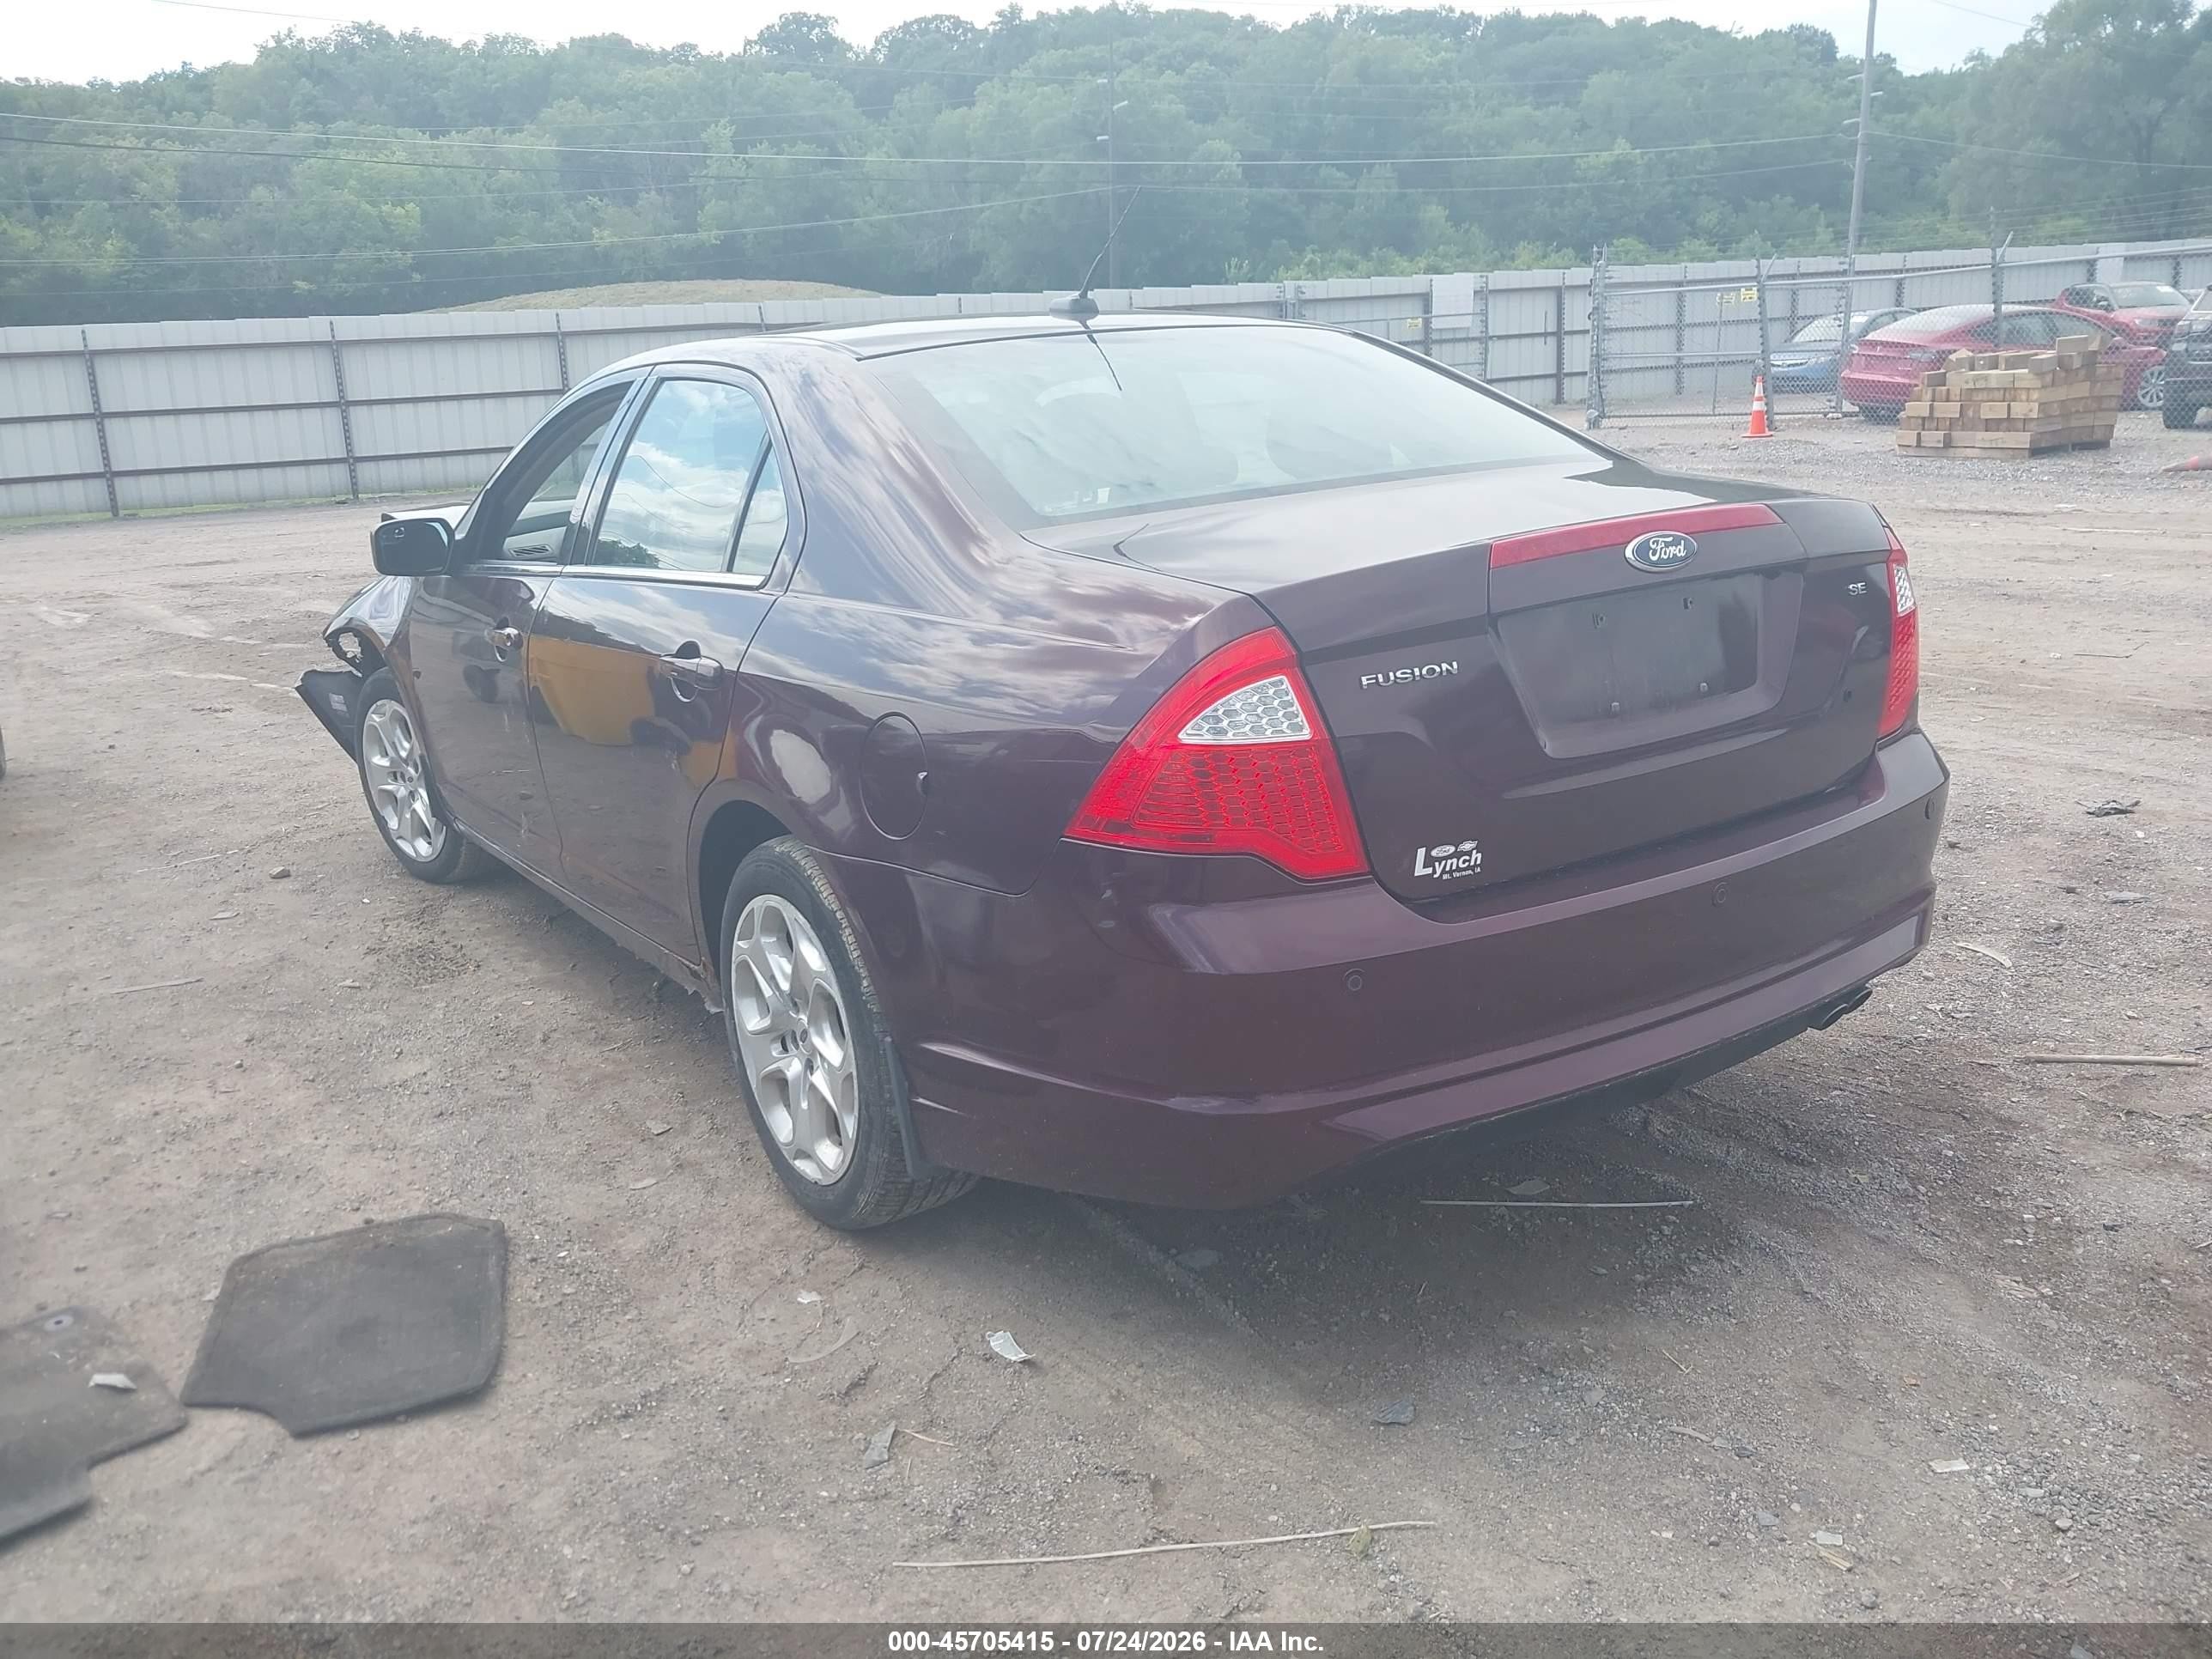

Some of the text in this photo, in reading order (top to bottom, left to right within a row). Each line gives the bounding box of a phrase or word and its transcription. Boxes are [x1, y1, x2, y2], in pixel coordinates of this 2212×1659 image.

[1649, 537, 1686, 561] Ford
[1848, 582, 1867, 595] SE
[1360, 661, 1458, 689] FUSION
[1414, 847, 1482, 878] Lynch
